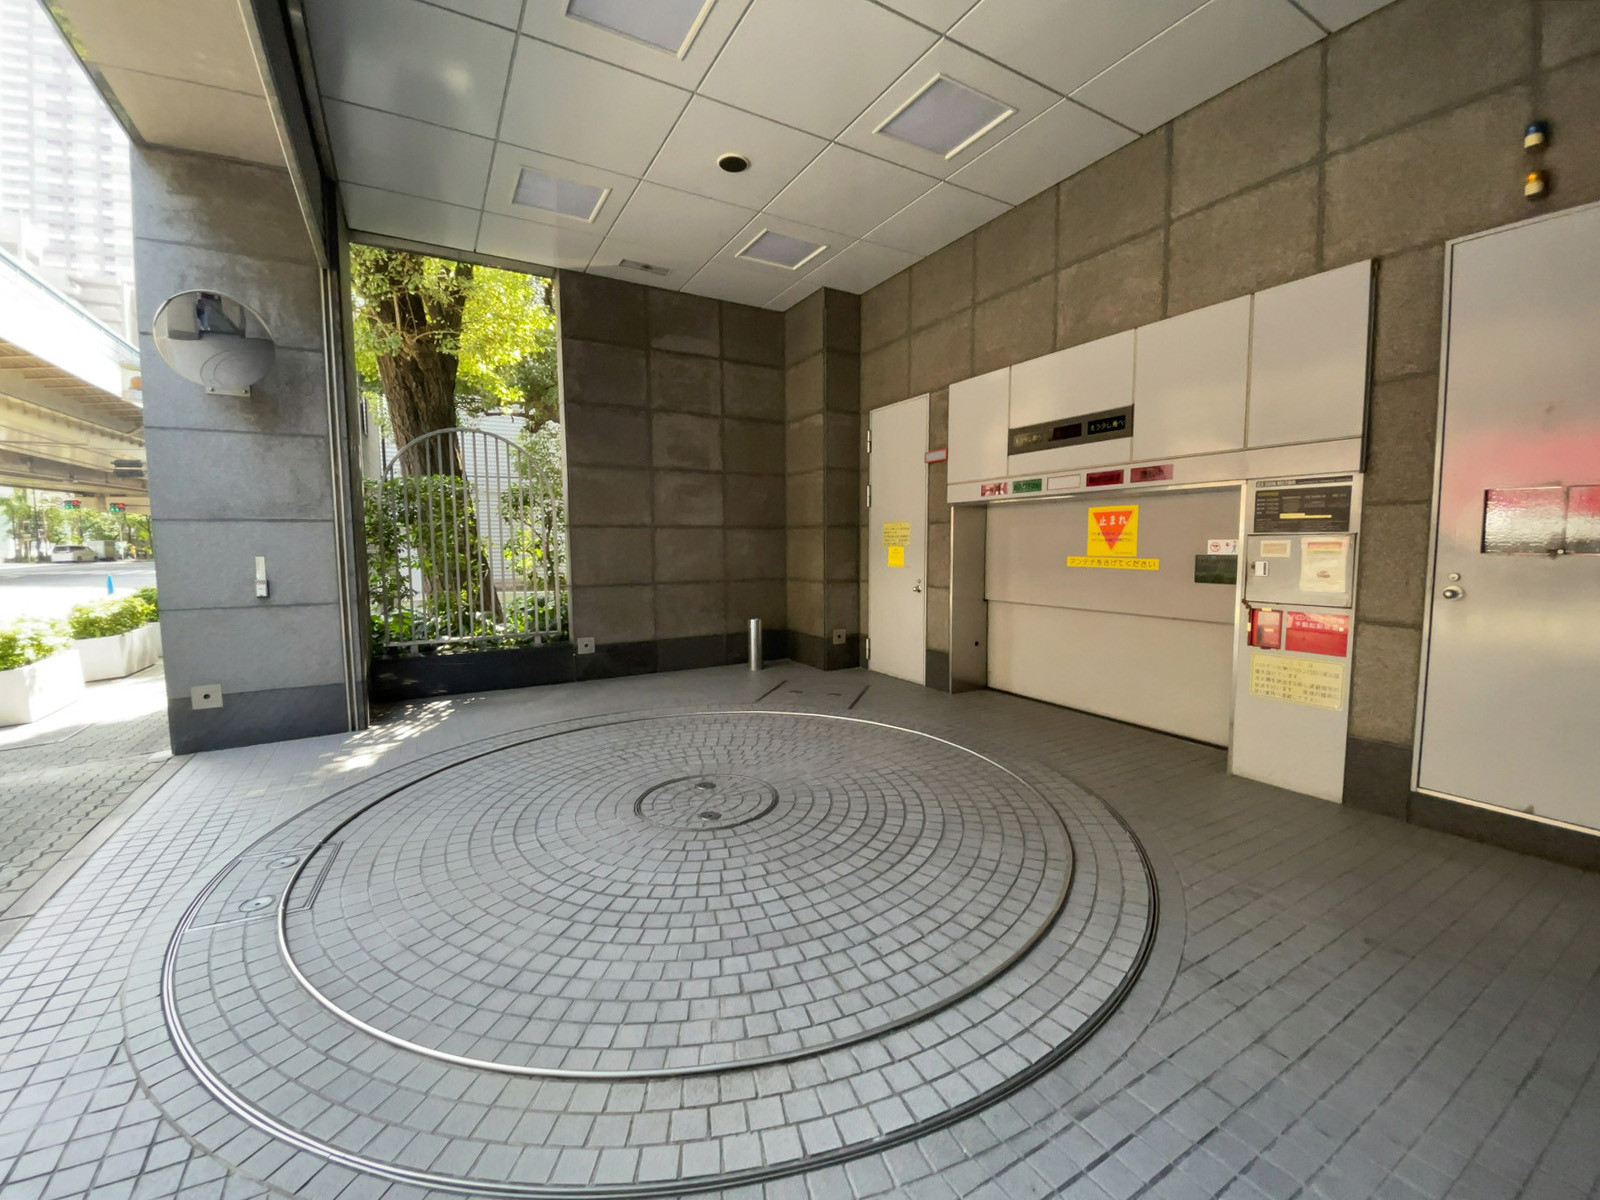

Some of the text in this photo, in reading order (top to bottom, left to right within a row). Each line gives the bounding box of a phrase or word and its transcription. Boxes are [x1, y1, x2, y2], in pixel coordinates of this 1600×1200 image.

[1098, 515, 1127, 526] 止まれ
[1070, 558, 1157, 568] アンテナをさげてください
